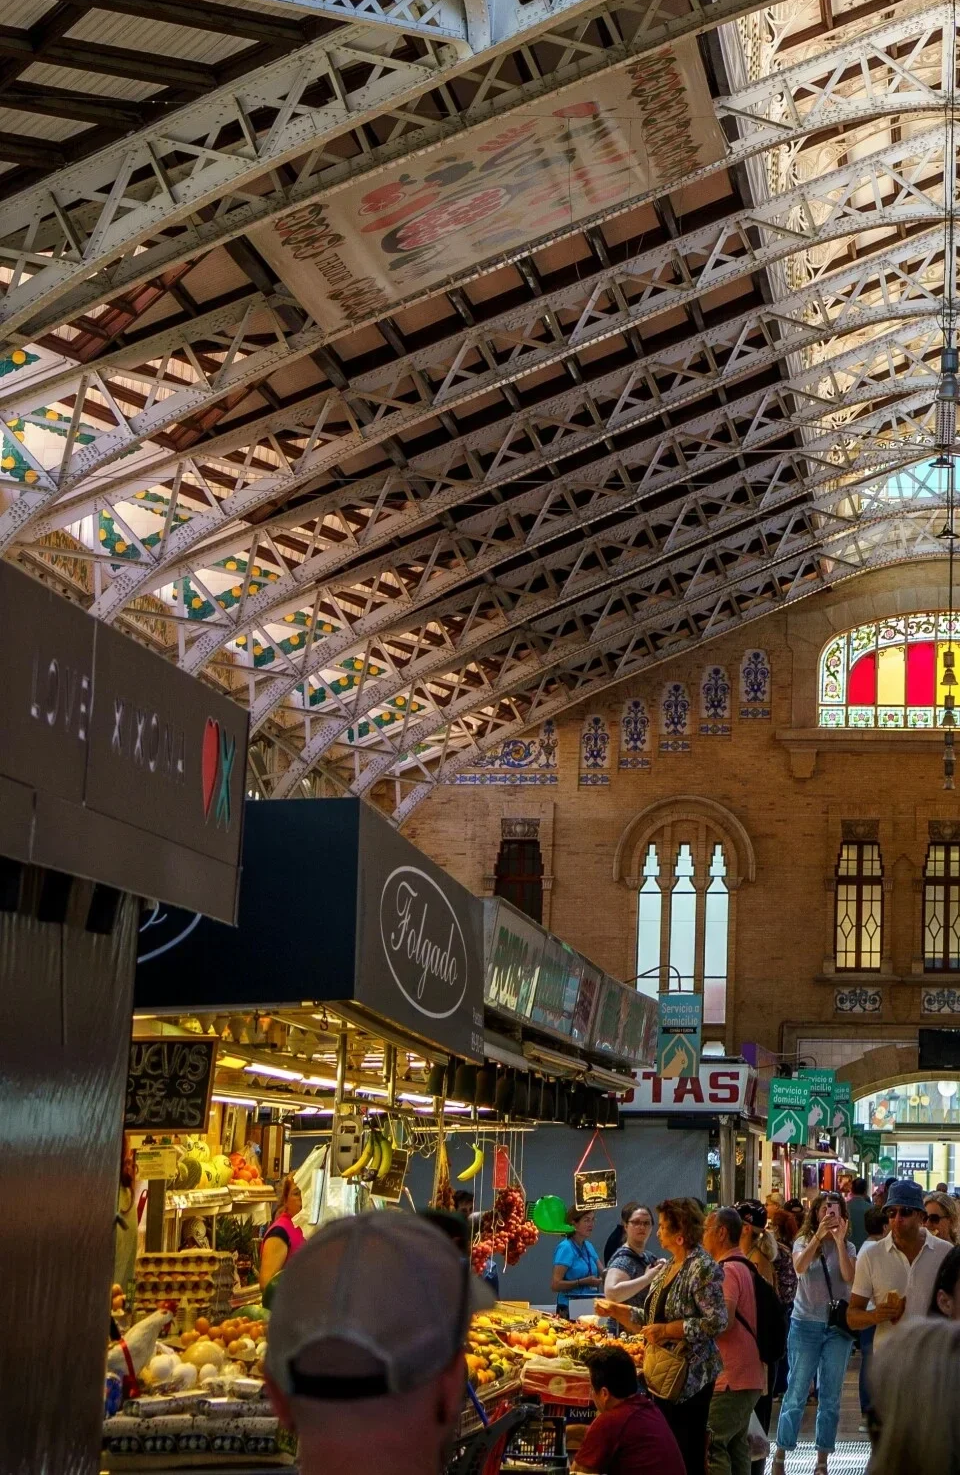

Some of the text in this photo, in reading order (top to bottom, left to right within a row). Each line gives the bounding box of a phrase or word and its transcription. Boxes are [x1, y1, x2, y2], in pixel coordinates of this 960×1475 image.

[314, 252, 353, 286] TARDOR
[391, 881, 458, 1000] Folgado
[661, 1002, 700, 1014] Servicio a
[662, 1015, 698, 1026] domicilio
[129, 1042, 209, 1082] UEVOS
[773, 1084, 802, 1095] Servicio
[773, 1095, 807, 1105] domicilio
